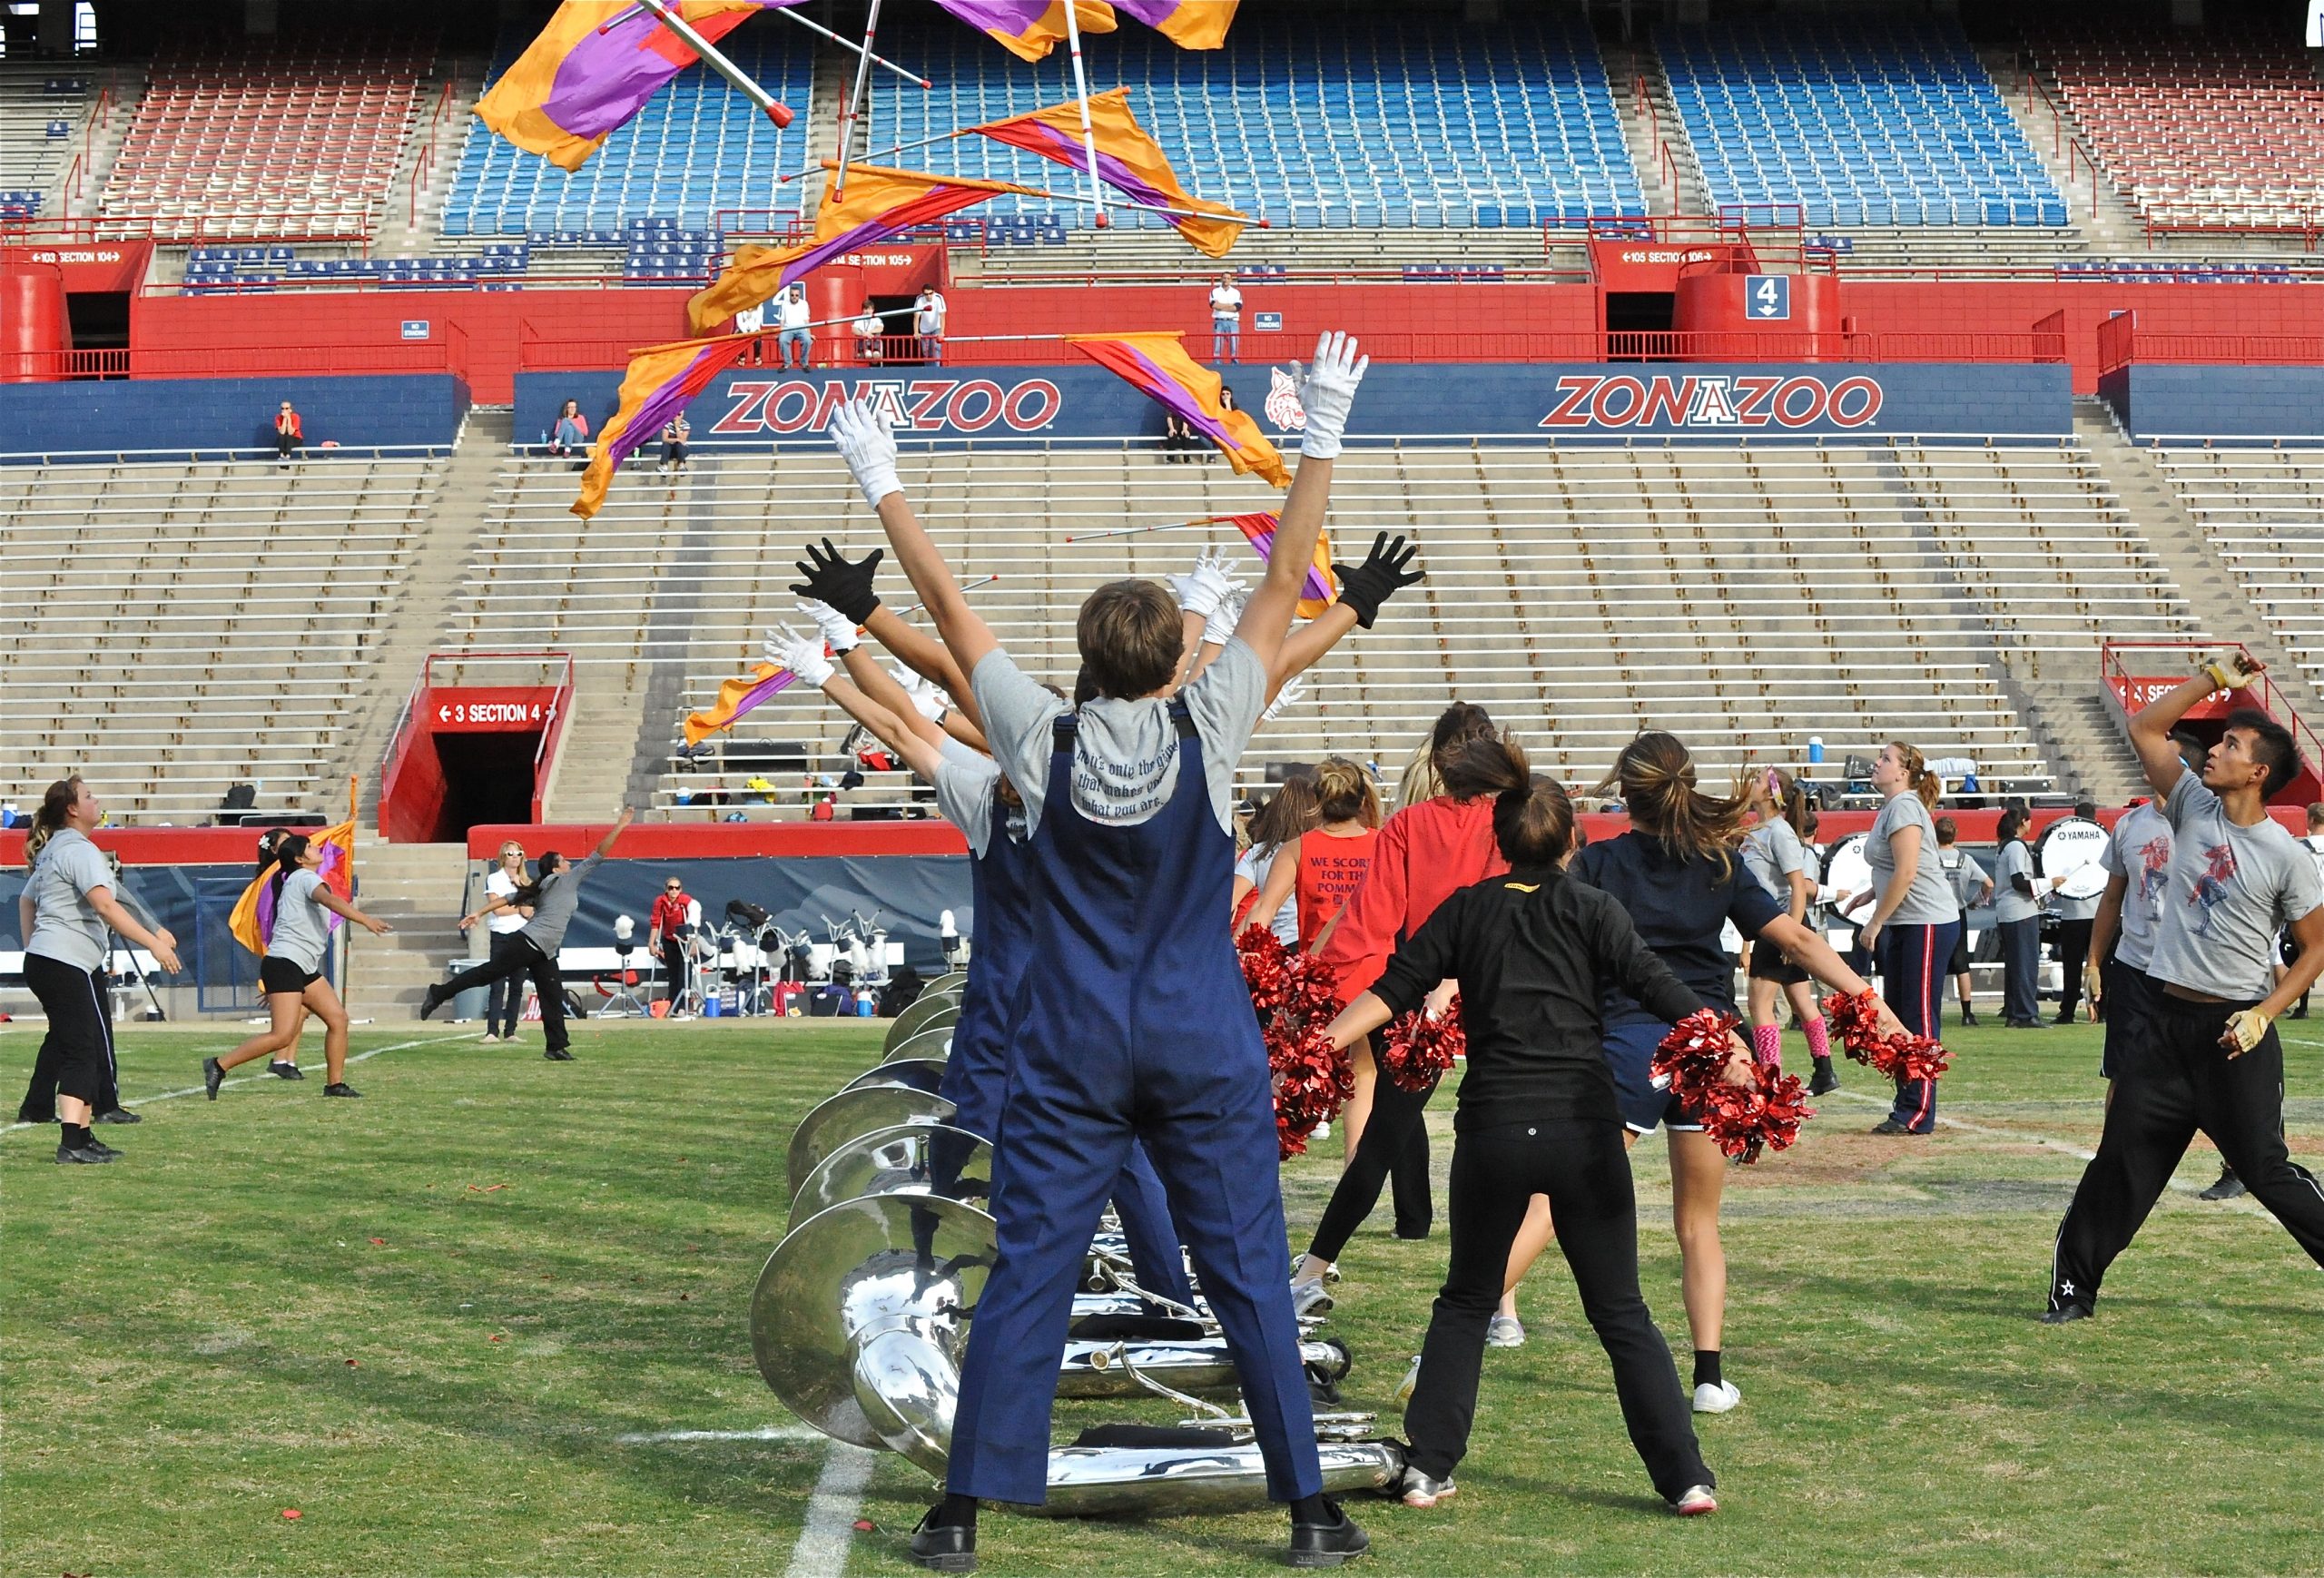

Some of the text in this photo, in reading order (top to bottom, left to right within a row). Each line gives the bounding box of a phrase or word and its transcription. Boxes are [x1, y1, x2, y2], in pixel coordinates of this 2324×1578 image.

[41, 251, 112, 262] 103 SECTION 104
[888, 255, 903, 265] 105
[1630, 251, 1646, 262] 105
[1689, 251, 1704, 262] 106
[1757, 279, 1778, 304] 4
[1538, 375, 1884, 429] ZONAZOO
[455, 704, 541, 723] 3 SECTION 4
[1108, 763, 1135, 780] only
[1104, 783, 1144, 799] makes
[1081, 796, 1111, 817] what
[1114, 804, 1137, 818] you
[2067, 830, 2101, 841] YAMAHA
[1310, 857, 1329, 867] WE
[1322, 871, 1364, 881] FOR TH
